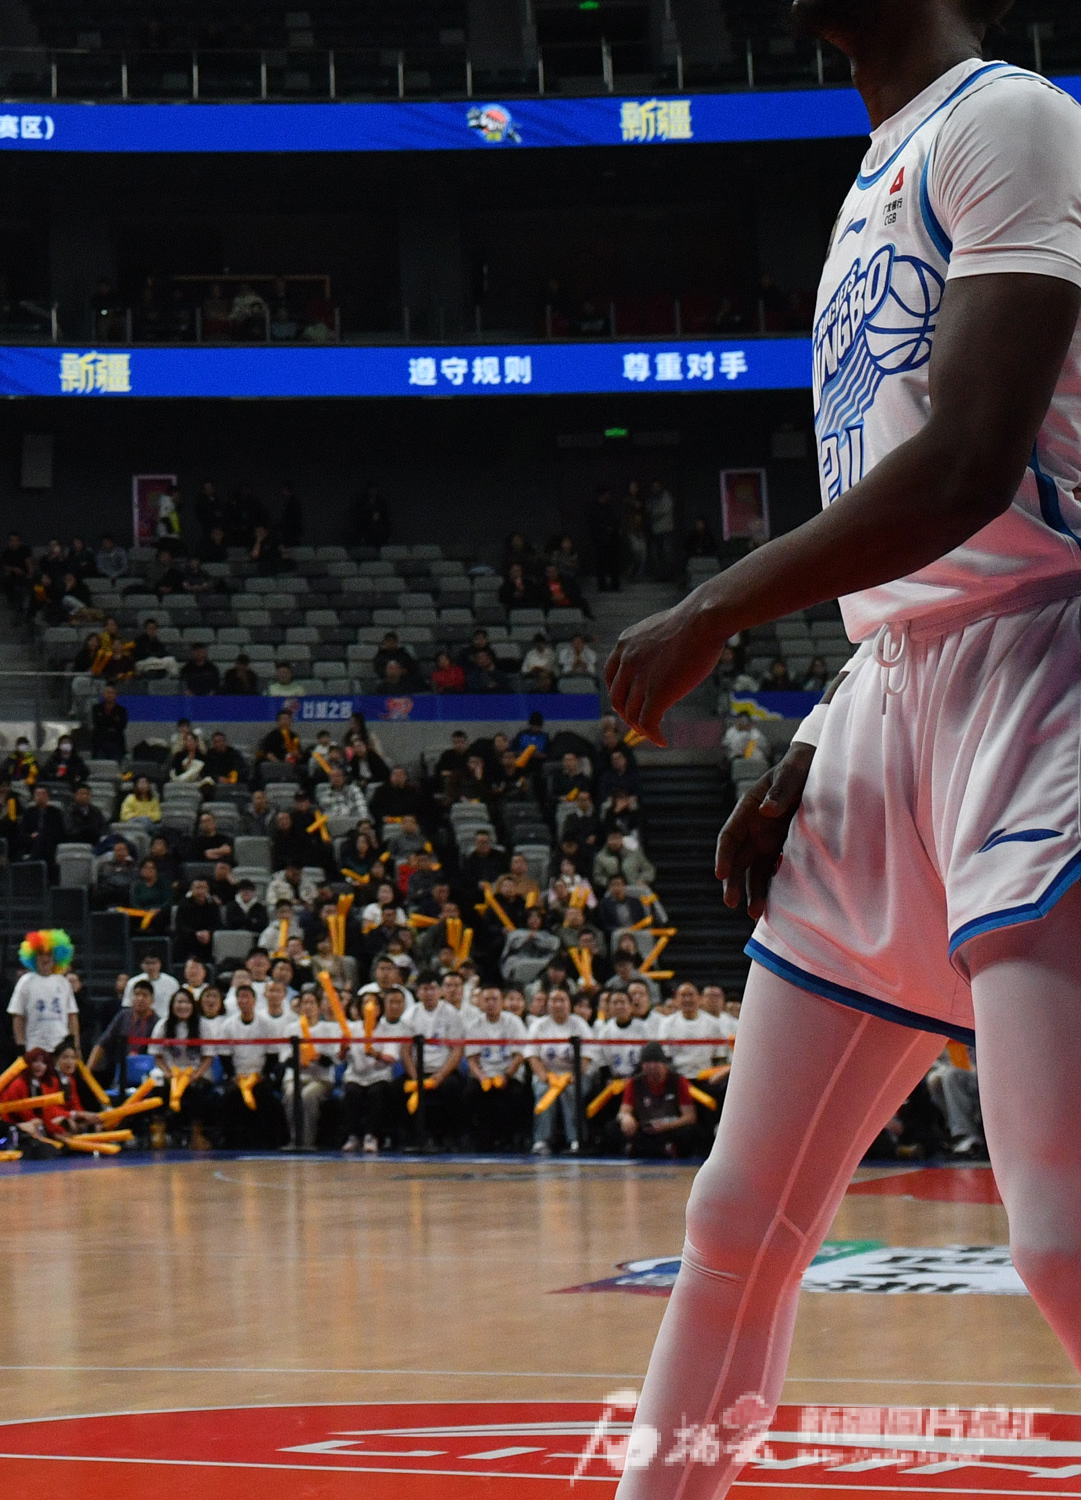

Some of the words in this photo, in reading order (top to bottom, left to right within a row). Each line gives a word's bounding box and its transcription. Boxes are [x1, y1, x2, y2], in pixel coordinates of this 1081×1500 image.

[619, 98, 694, 143] 新疆
[883, 212, 897, 226] CGB
[59, 352, 133, 395] 新疆
[408, 355, 533, 387] 遵守规则
[622, 351, 749, 383] 尊重对手
